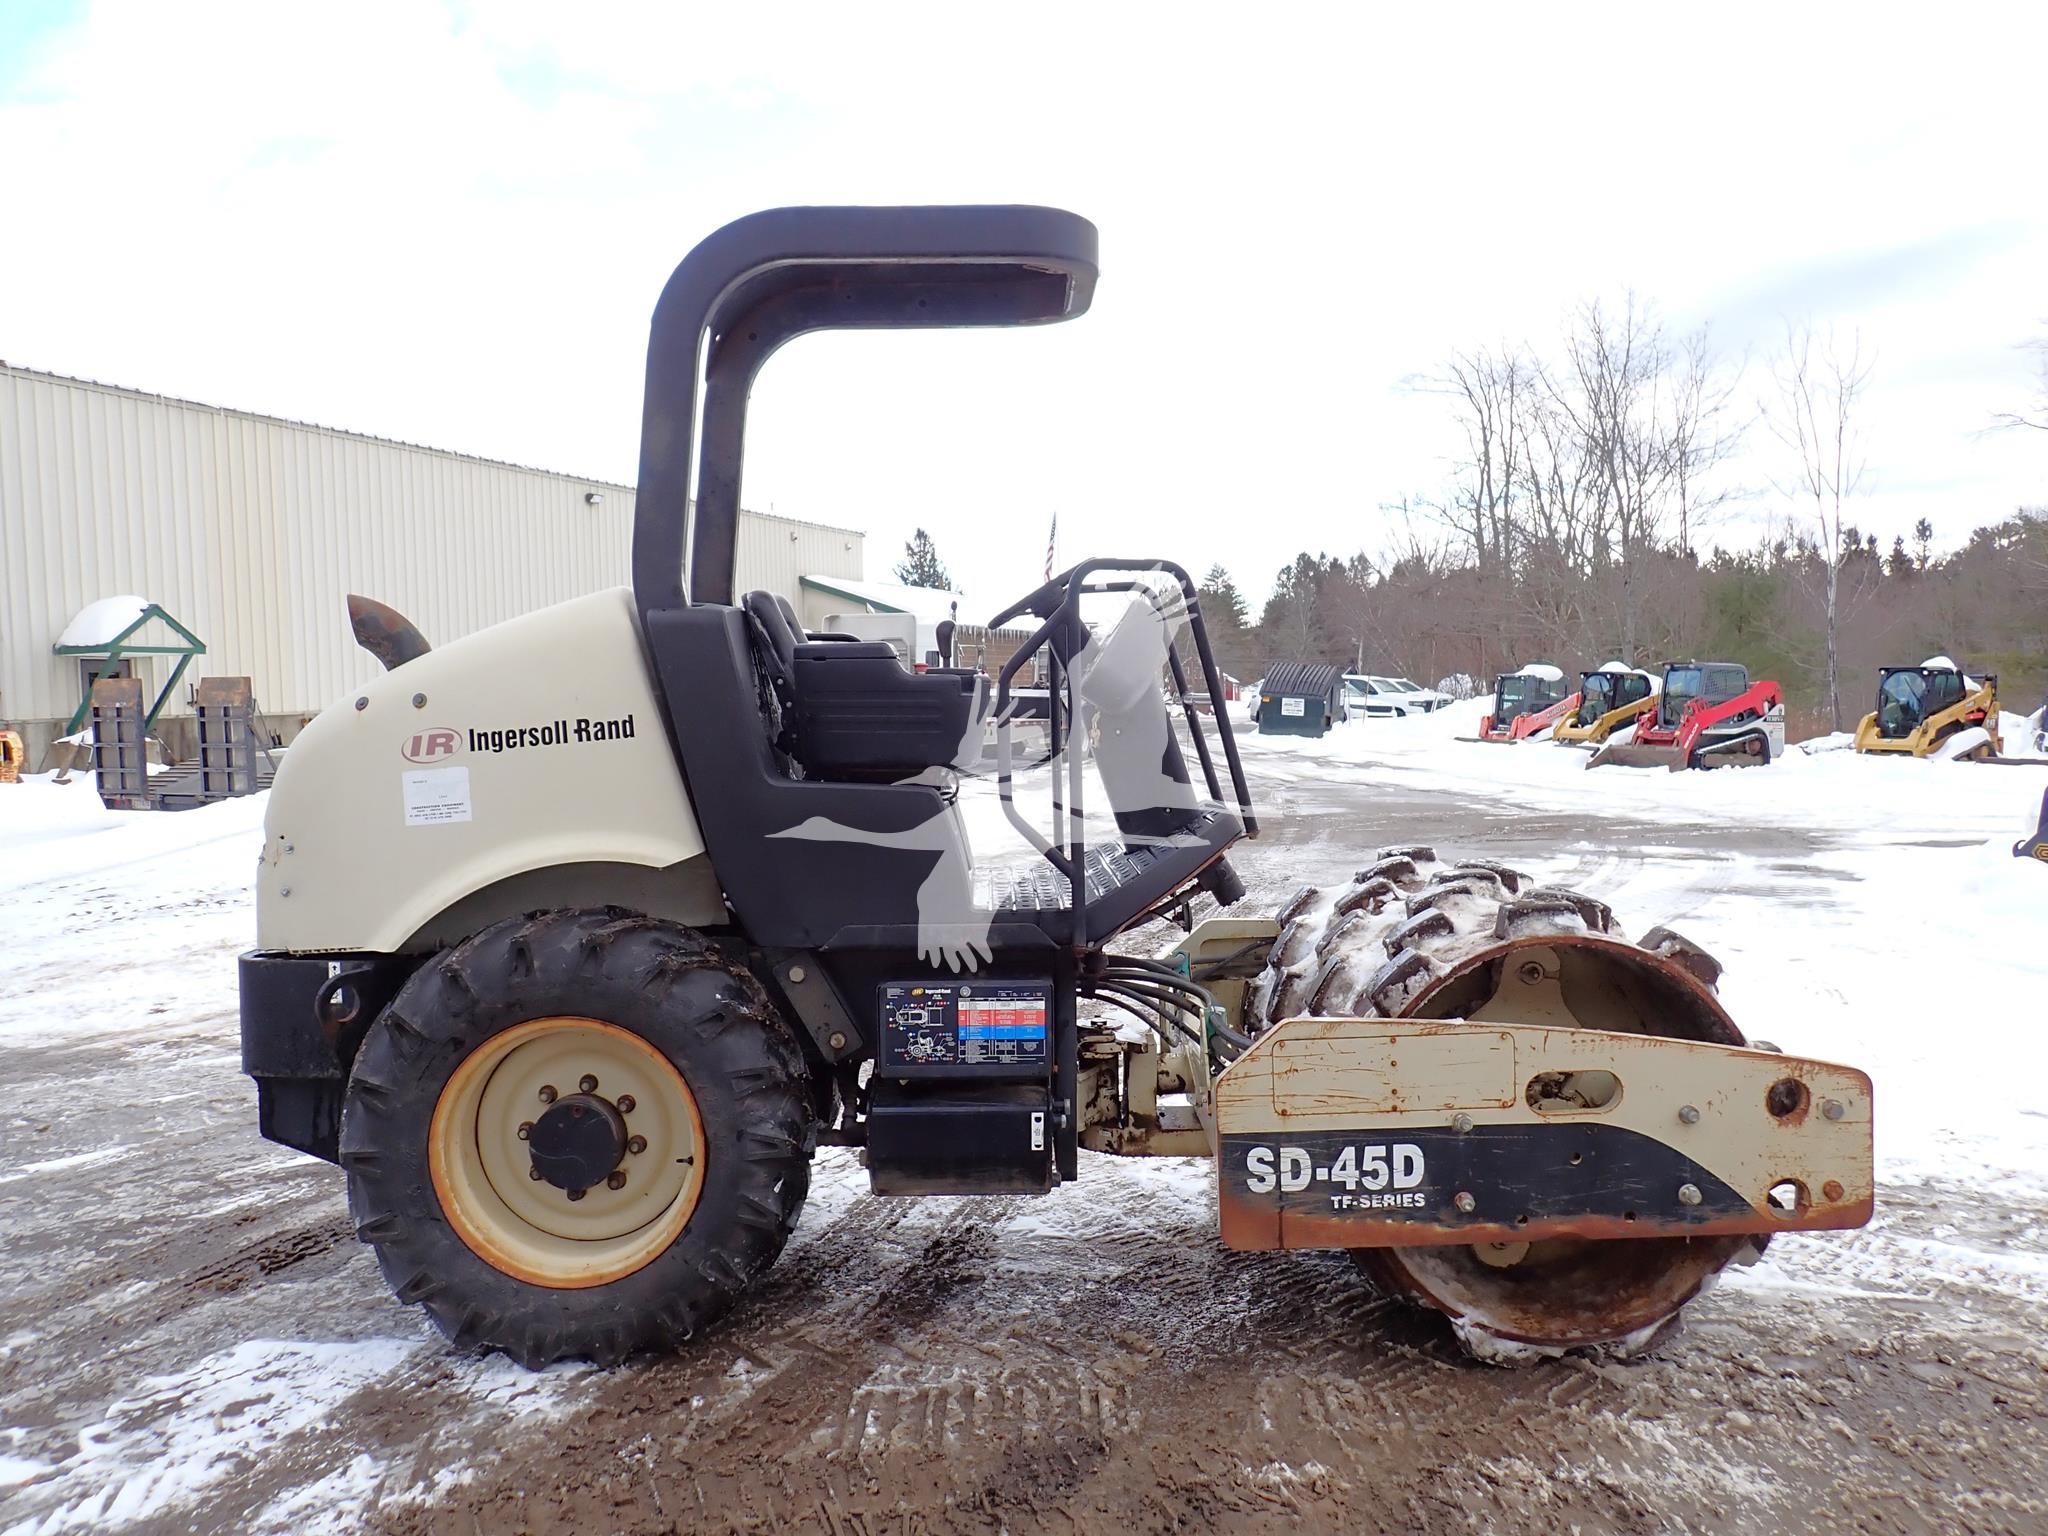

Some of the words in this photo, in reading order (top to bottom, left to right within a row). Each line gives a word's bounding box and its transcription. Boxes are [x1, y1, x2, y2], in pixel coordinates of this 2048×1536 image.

[409, 732, 456, 758] IR
[468, 719, 568, 753] Ingersoll
[1246, 1143, 1425, 1194] SD-45D
[1330, 1193, 1426, 1209] TF-SERIES
